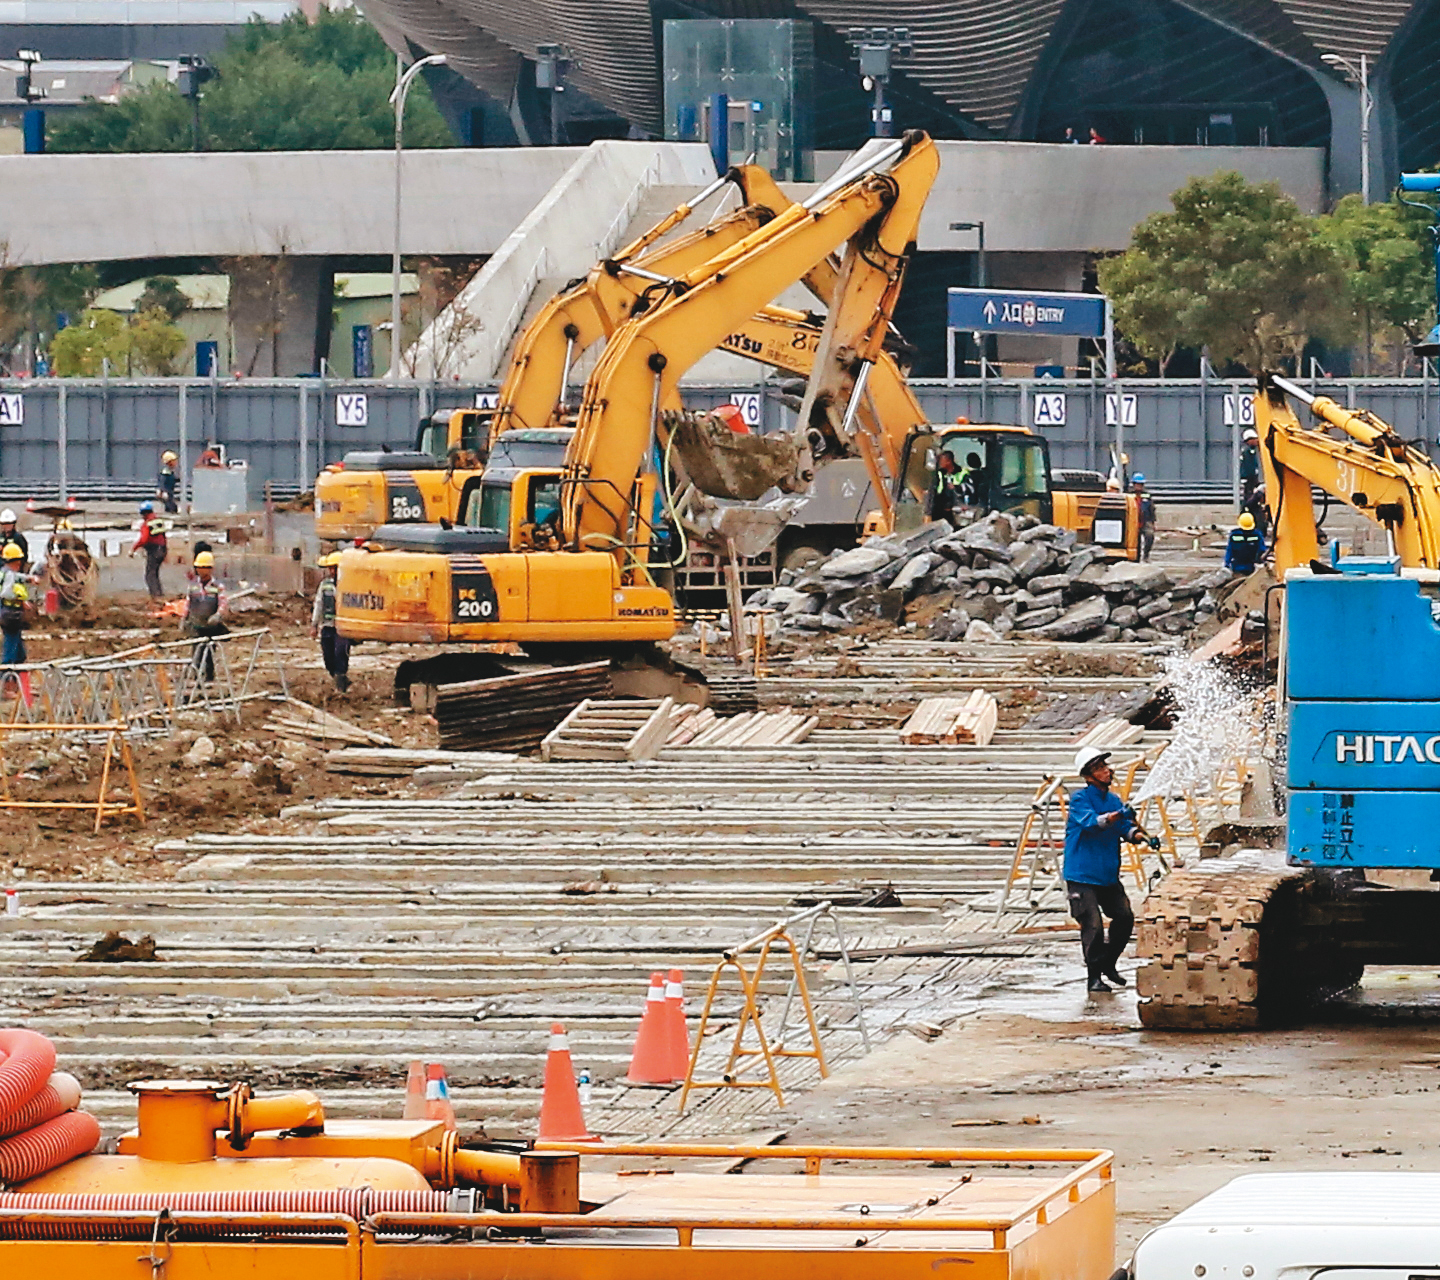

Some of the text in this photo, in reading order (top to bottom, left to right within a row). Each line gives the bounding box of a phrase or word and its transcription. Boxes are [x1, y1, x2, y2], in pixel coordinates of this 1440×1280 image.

[1001, 304, 1065, 322] 入口 ENTRY
[340, 397, 364, 423] Y5
[734, 397, 759, 422] Y6
[1037, 396, 1063, 422] A3
[393, 497, 409, 508] PC
[392, 506, 421, 520] 200
[458, 588, 476, 601] PC
[458, 601, 492, 617] 200
[617, 605, 669, 617] KOMATSU
